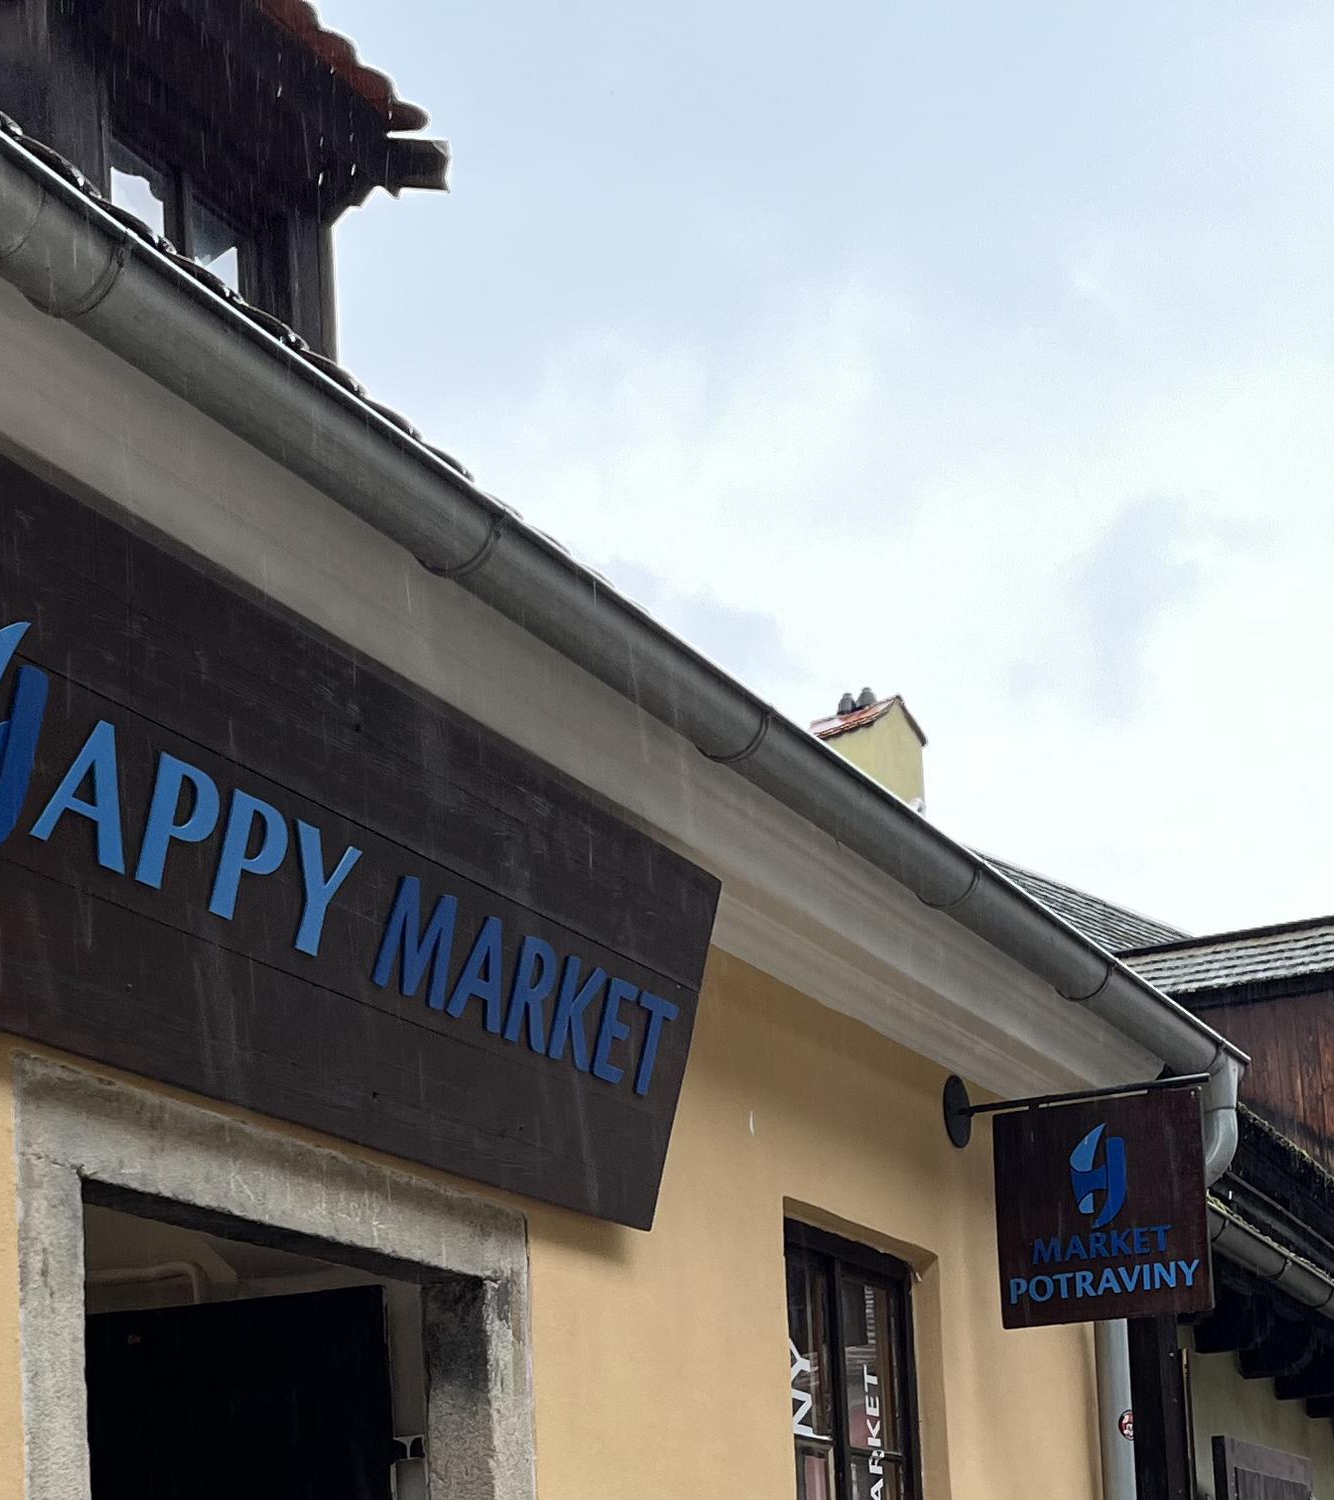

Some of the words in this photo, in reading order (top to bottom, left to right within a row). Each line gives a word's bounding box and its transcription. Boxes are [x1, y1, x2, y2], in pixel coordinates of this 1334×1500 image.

[373, 876, 680, 1095] MARKET
[1034, 1224, 1171, 1264] MARKET
[1010, 1259, 1200, 1304] POTRAVINY
